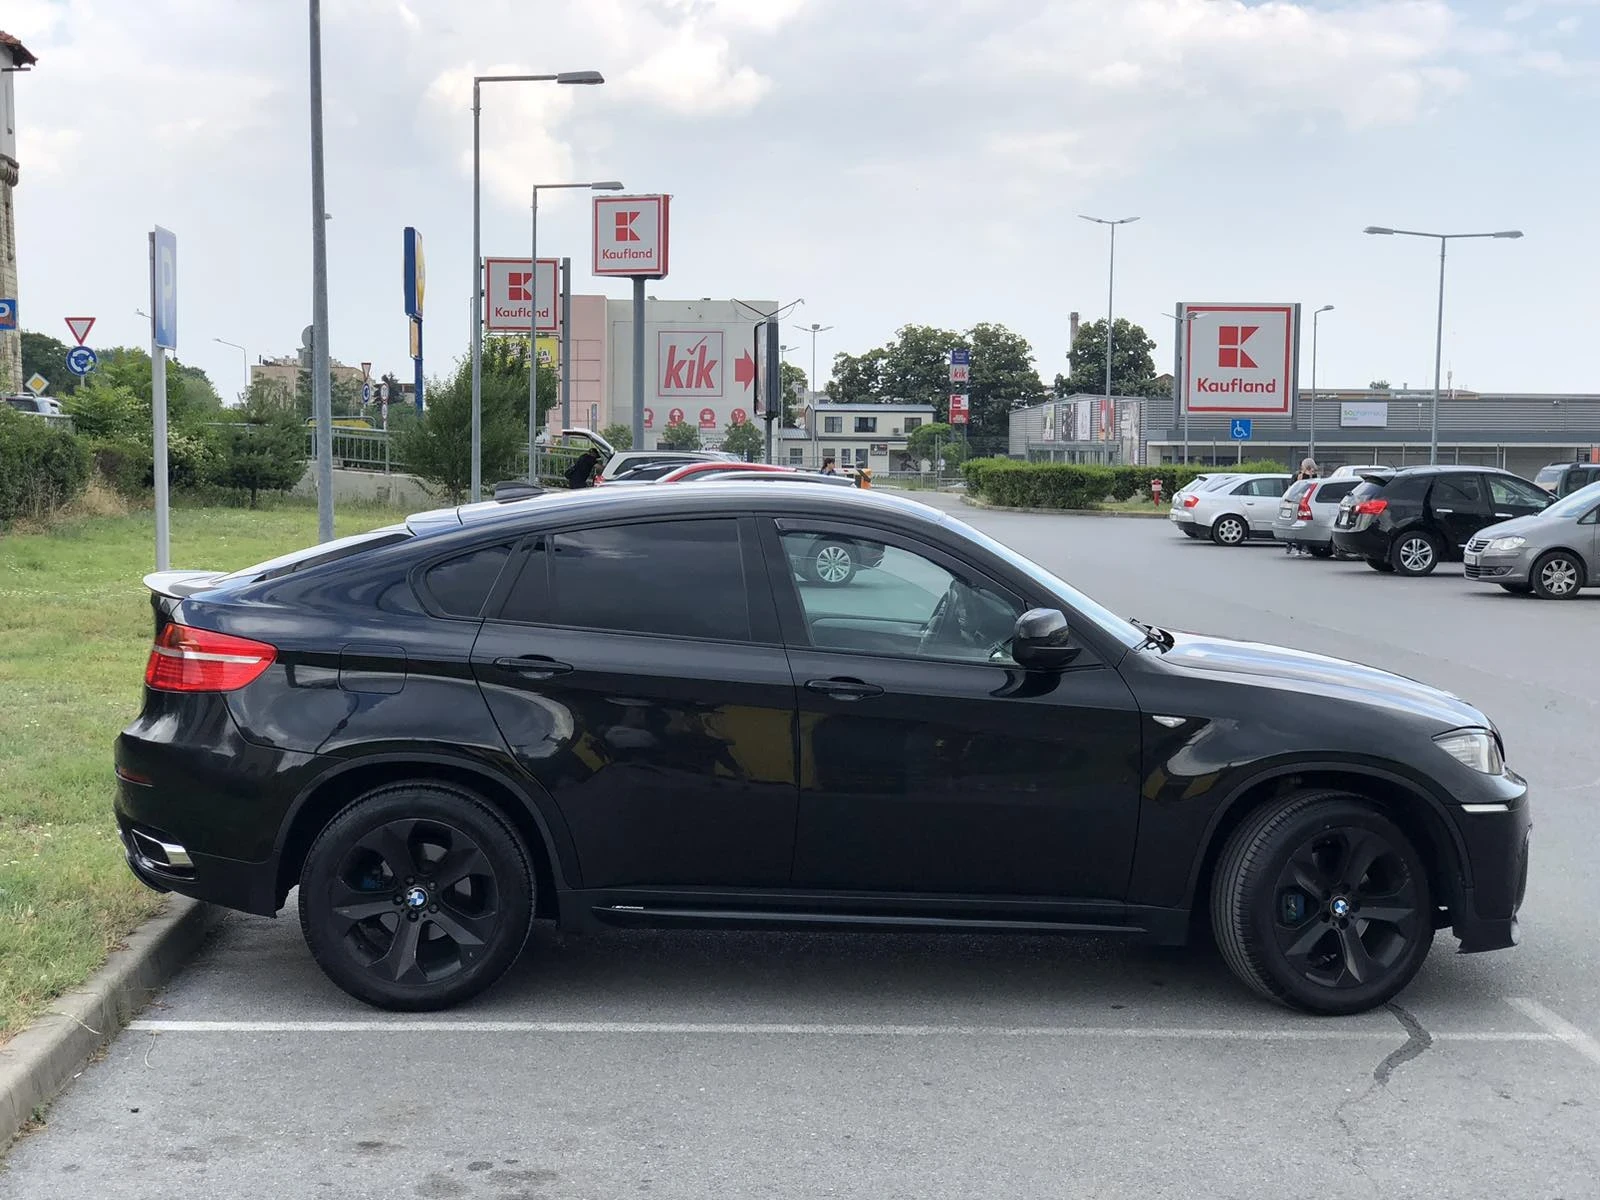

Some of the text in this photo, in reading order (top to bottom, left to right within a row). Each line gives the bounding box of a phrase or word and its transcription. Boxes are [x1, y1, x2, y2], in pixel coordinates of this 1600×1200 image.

[602, 248, 653, 259] Kaufland
[664, 337, 718, 388] kik
[1197, 378, 1276, 393] Kaufland
